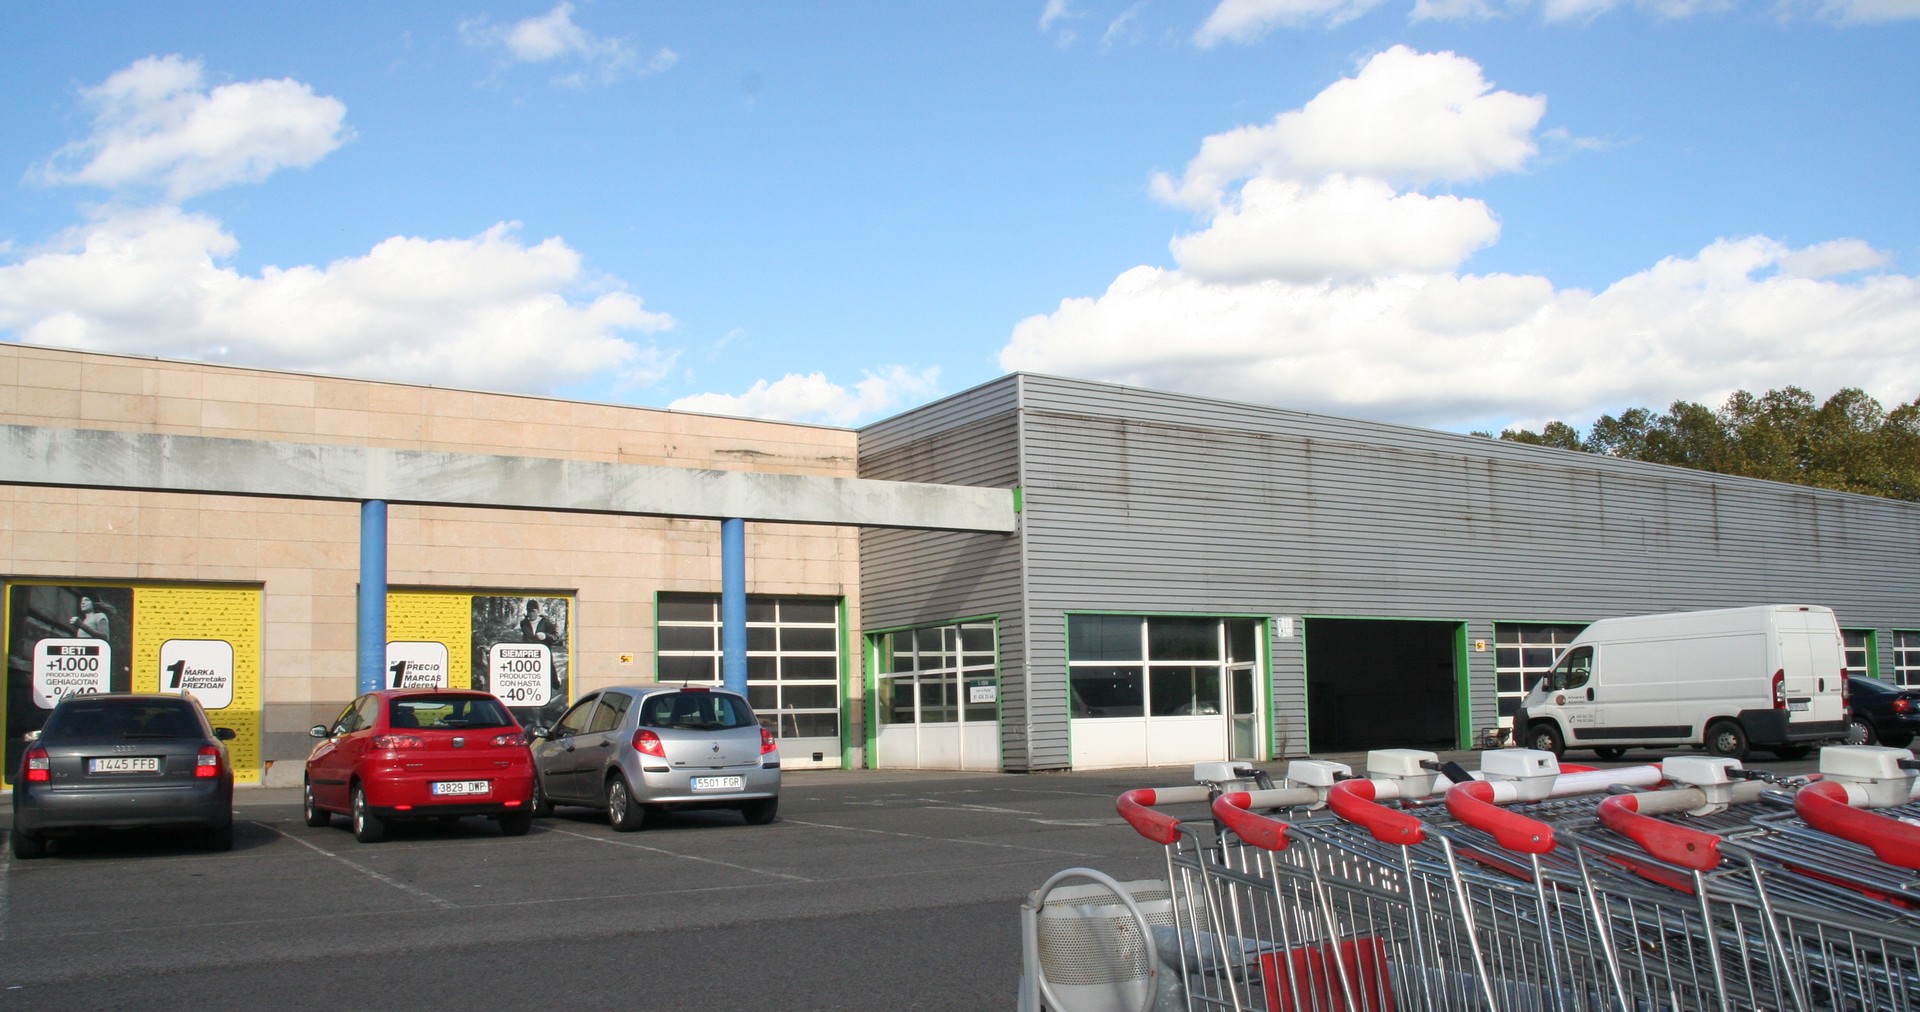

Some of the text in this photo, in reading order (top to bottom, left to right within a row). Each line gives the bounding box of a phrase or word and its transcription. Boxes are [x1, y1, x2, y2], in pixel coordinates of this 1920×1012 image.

[61, 646, 86, 655] BETI
[501, 650, 540, 658] SIEMPRE
[46, 657, 99, 671] +1.000
[500, 660, 541, 673] +1.000
[166, 660, 186, 688] 1
[389, 660, 407, 688] 1
[499, 687, 542, 701] -40%
[99, 759, 156, 770] 1445 FFB
[440, 782, 485, 793] 3829 DWP
[698, 777, 739, 787] 5501 FGR
